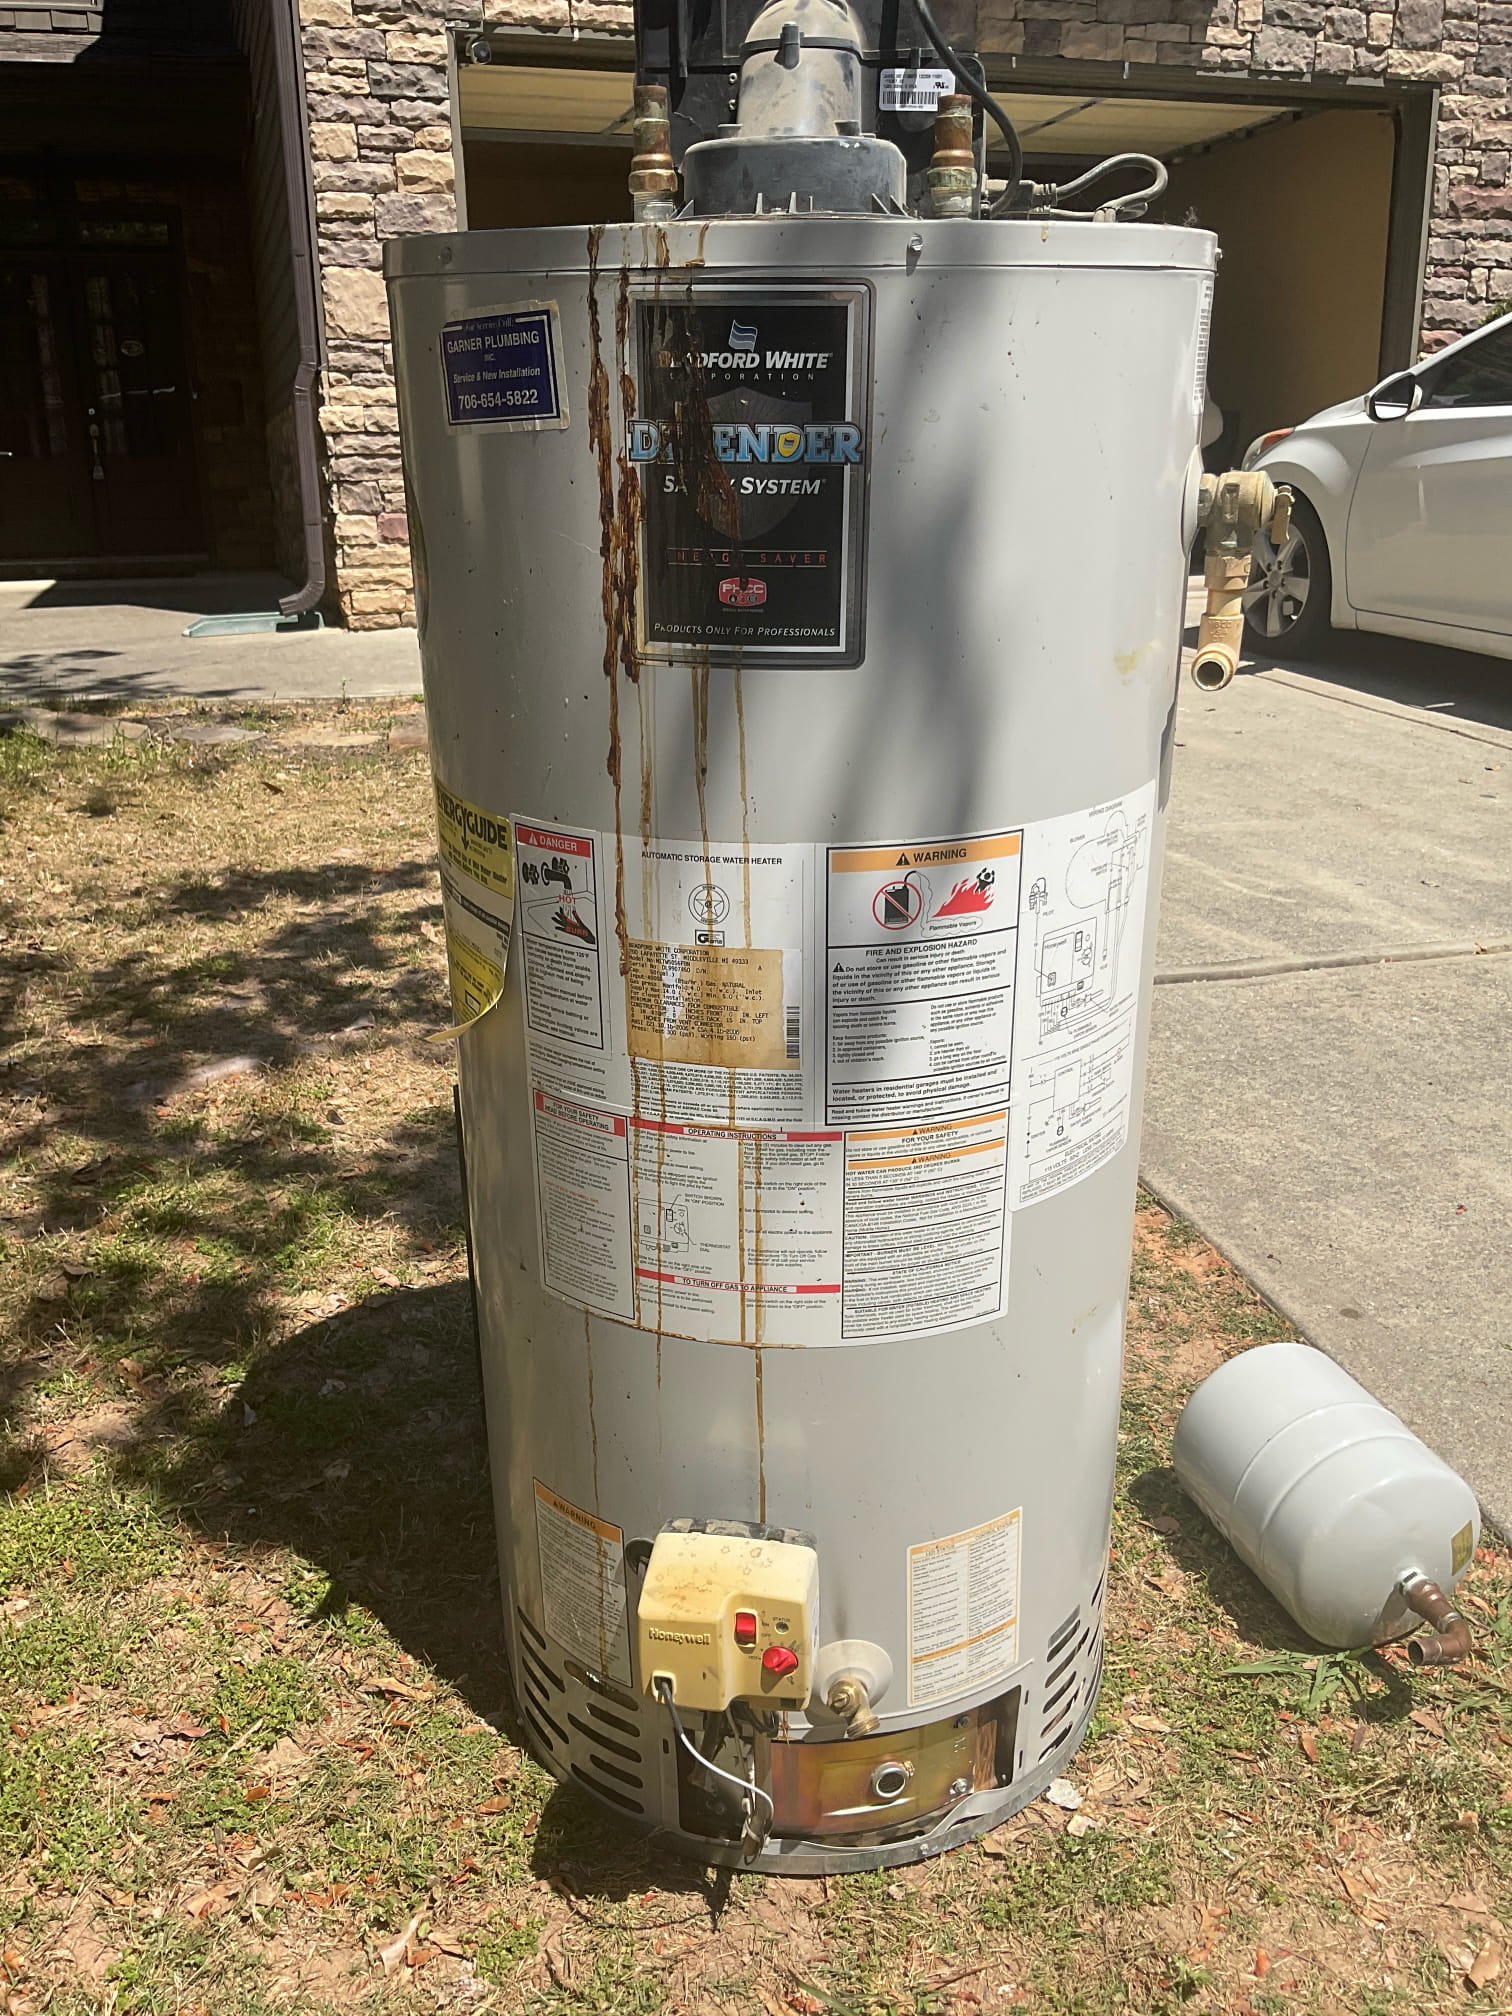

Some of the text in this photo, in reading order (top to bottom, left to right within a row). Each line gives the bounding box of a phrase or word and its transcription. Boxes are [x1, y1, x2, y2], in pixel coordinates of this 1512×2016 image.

[448, 331, 539, 353] GARNER PLUMBING
[766, 351, 828, 369] WHITE
[454, 373, 475, 383] Service
[483, 370, 497, 380] New
[499, 367, 540, 378] Installation
[459, 389, 538, 410] 706-654-5822
[740, 477, 820, 495] SYSTEM
[760, 552, 826, 564] SAVER
[706, 625, 731, 635] ONLY
[735, 626, 753, 636] FOR
[758, 627, 835, 637] PROFESSIONALS
[540, 836, 577, 851] DANGER
[642, 851, 682, 861] AUTOMATIC
[684, 855, 720, 863] STORAGE
[913, 848, 967, 863] WARNING
[558, 895, 576, 904] HOT
[865, 949, 884, 957] FIRE
[903, 942, 946, 954] EXPLOSION
[948, 939, 978, 948] HAZARD
[883, 1082, 914, 1091] residential
[915, 1080, 938, 1089] garages
[963, 1072, 986, 1080] installed
[923, 1087, 946, 1095] physical
[558, 1110, 577, 1121] BEFORE
[579, 1118, 608, 1130] OPERATING
[563, 1106, 577, 1115] YOUR
[579, 1111, 599, 1120] SAFETY
[688, 1128, 777, 1140] OPERATING INSTRUCTIONS
[917, 1134, 934, 1142] YOUR
[936, 1131, 958, 1140] SAFETY
[919, 1124, 953, 1134] WARNING
[918, 1153, 951, 1163] WARNING
[692, 1279, 709, 1287] TURN
[725, 1283, 739, 1291] GAS
[750, 1285, 788, 1293] APPLIANCE
[558, 1502, 596, 1530] WARNING
[649, 1628, 711, 1645] Honeywell
